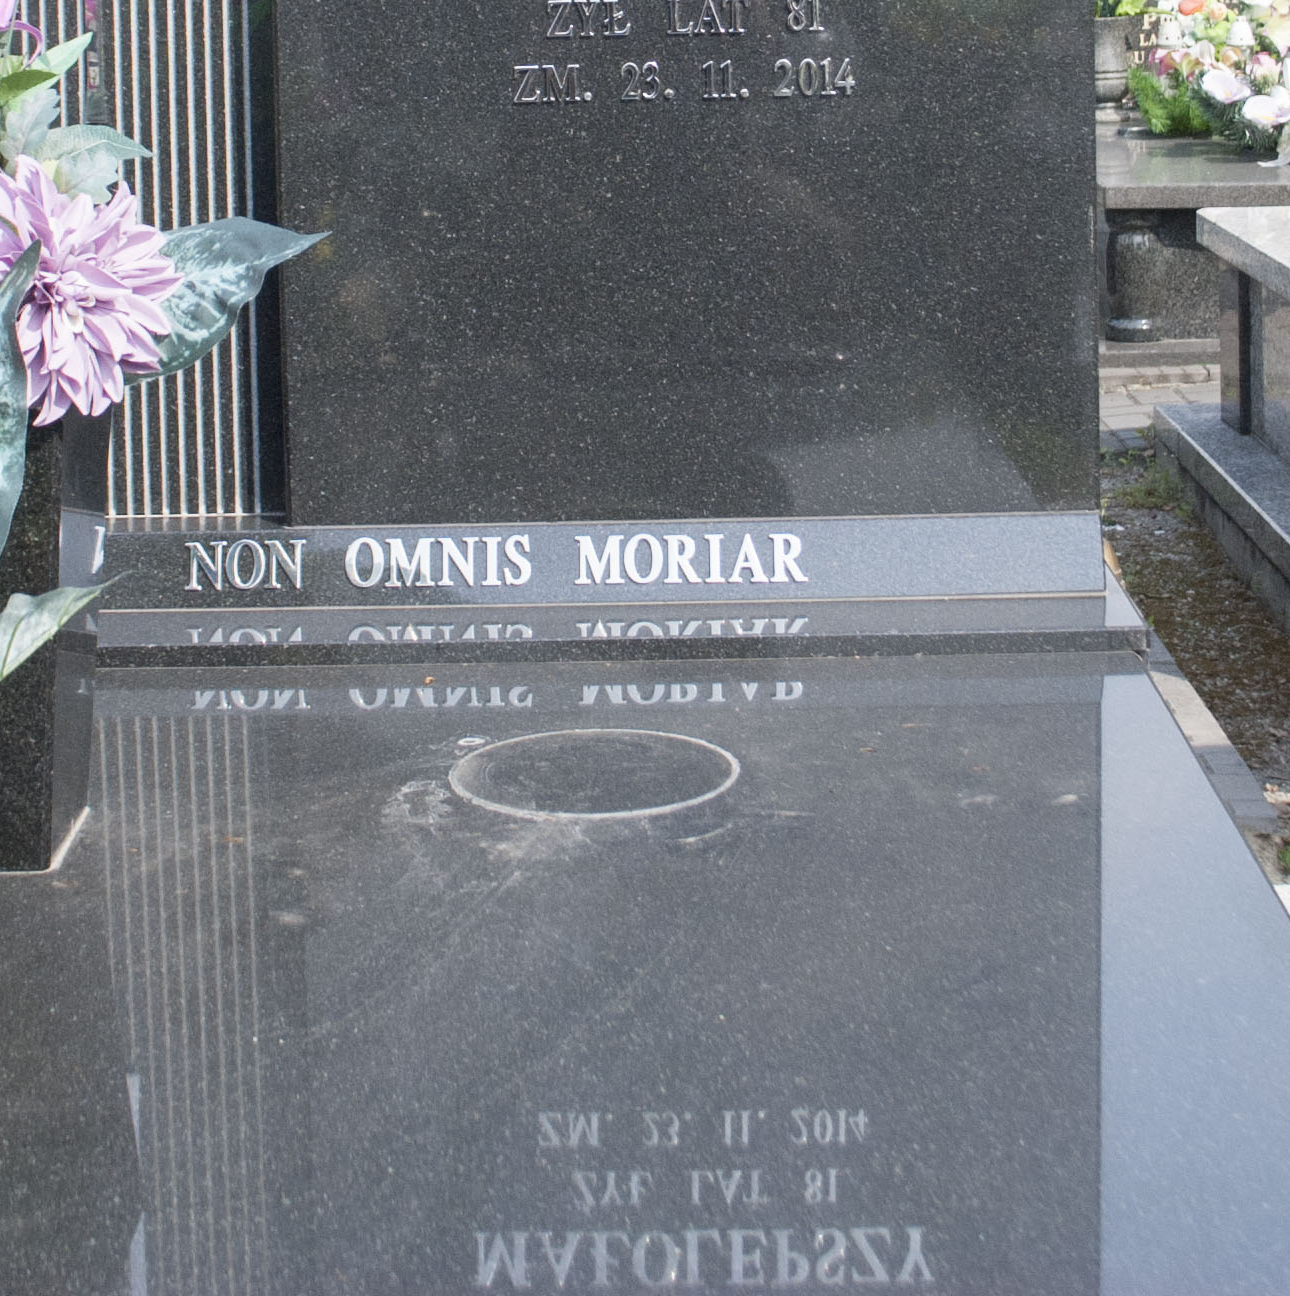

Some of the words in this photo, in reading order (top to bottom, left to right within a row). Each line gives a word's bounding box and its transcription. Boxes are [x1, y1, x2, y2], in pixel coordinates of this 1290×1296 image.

[514, 64, 593, 103] ZM.
[620, 61, 675, 101] 23.
[702, 60, 749, 99] 11.
[773, 57, 856, 97] 2014
[184, 538, 307, 592] NON
[345, 534, 533, 588] OMNIS
[574, 532, 809, 586] MORIAR
